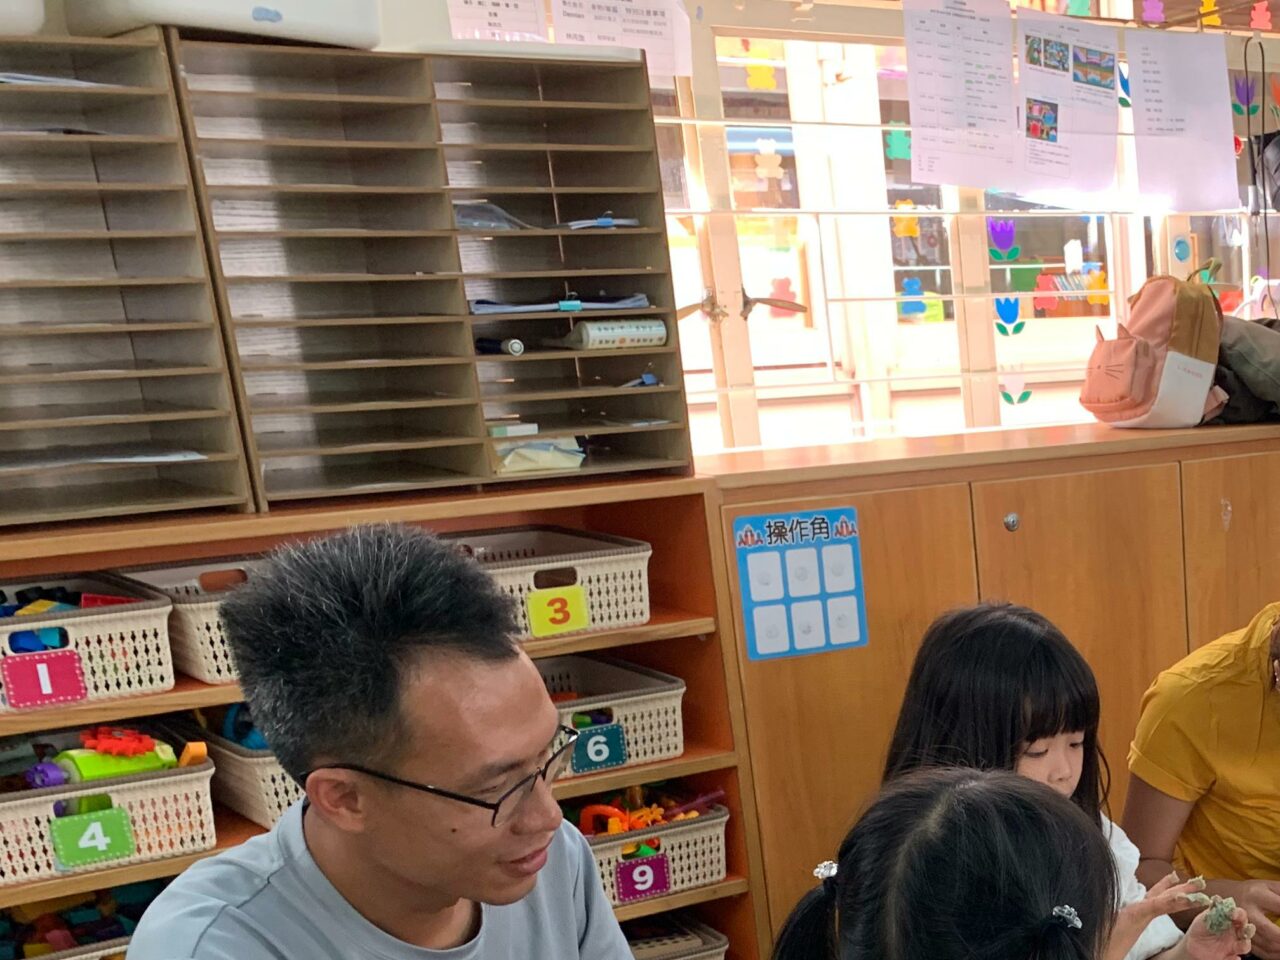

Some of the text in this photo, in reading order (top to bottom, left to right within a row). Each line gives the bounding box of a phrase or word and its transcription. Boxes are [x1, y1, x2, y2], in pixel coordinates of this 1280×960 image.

[765, 516, 830, 545] 操作角
[546, 597, 571, 625] 3
[36, 662, 53, 695] 1
[586, 735, 610, 762] 6
[78, 821, 112, 852] 4
[632, 865, 654, 891] 9
